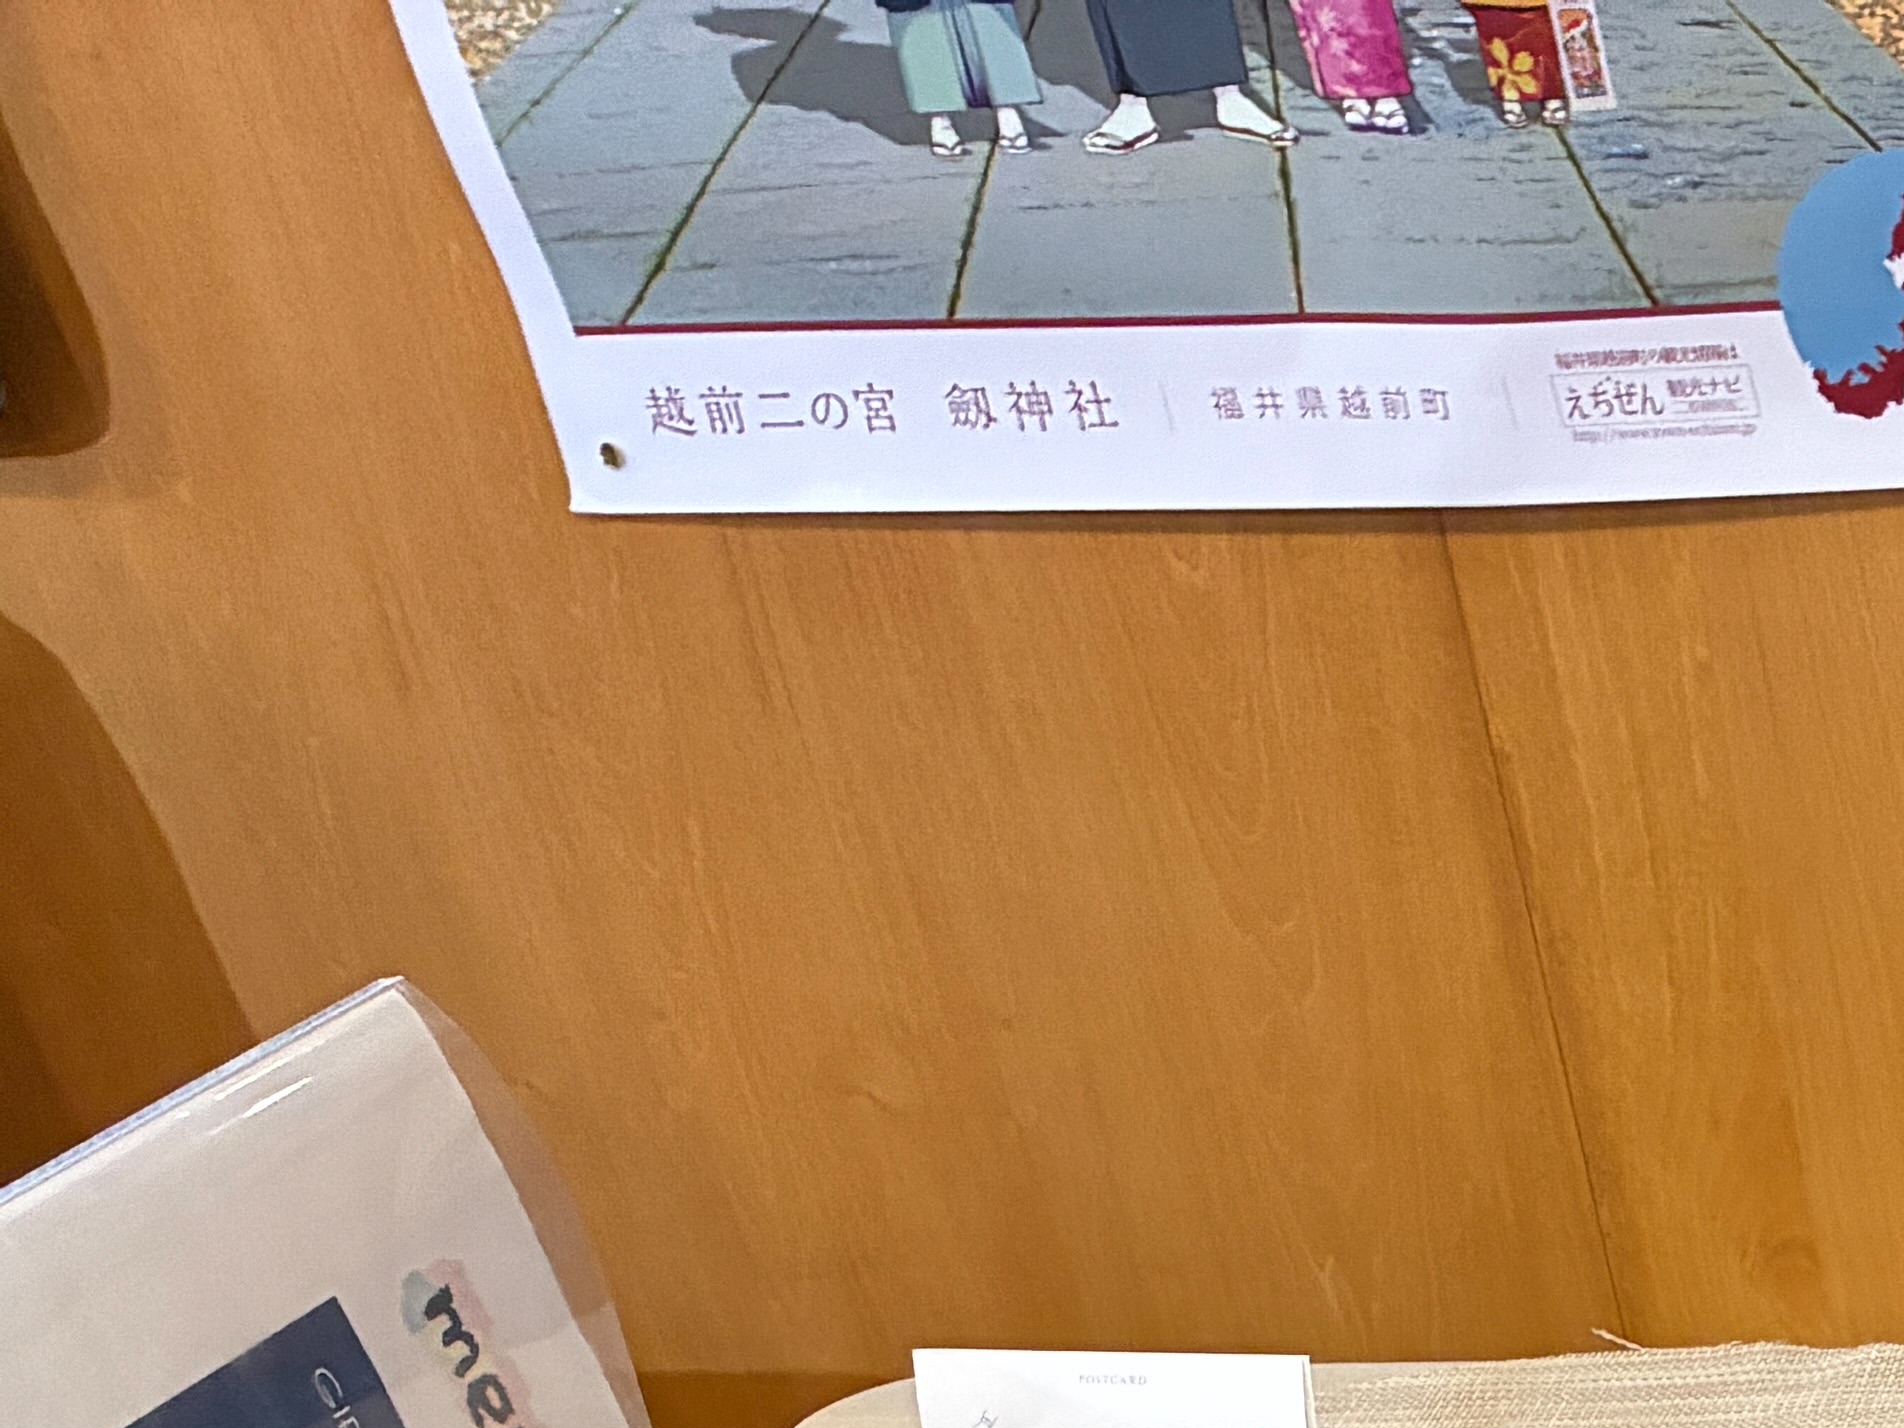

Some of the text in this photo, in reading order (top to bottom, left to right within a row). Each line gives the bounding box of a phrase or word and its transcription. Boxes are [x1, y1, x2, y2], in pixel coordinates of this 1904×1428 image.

[646, 382, 897, 437] 越前二の宮
[1211, 385, 1450, 421] 福井県越前町
